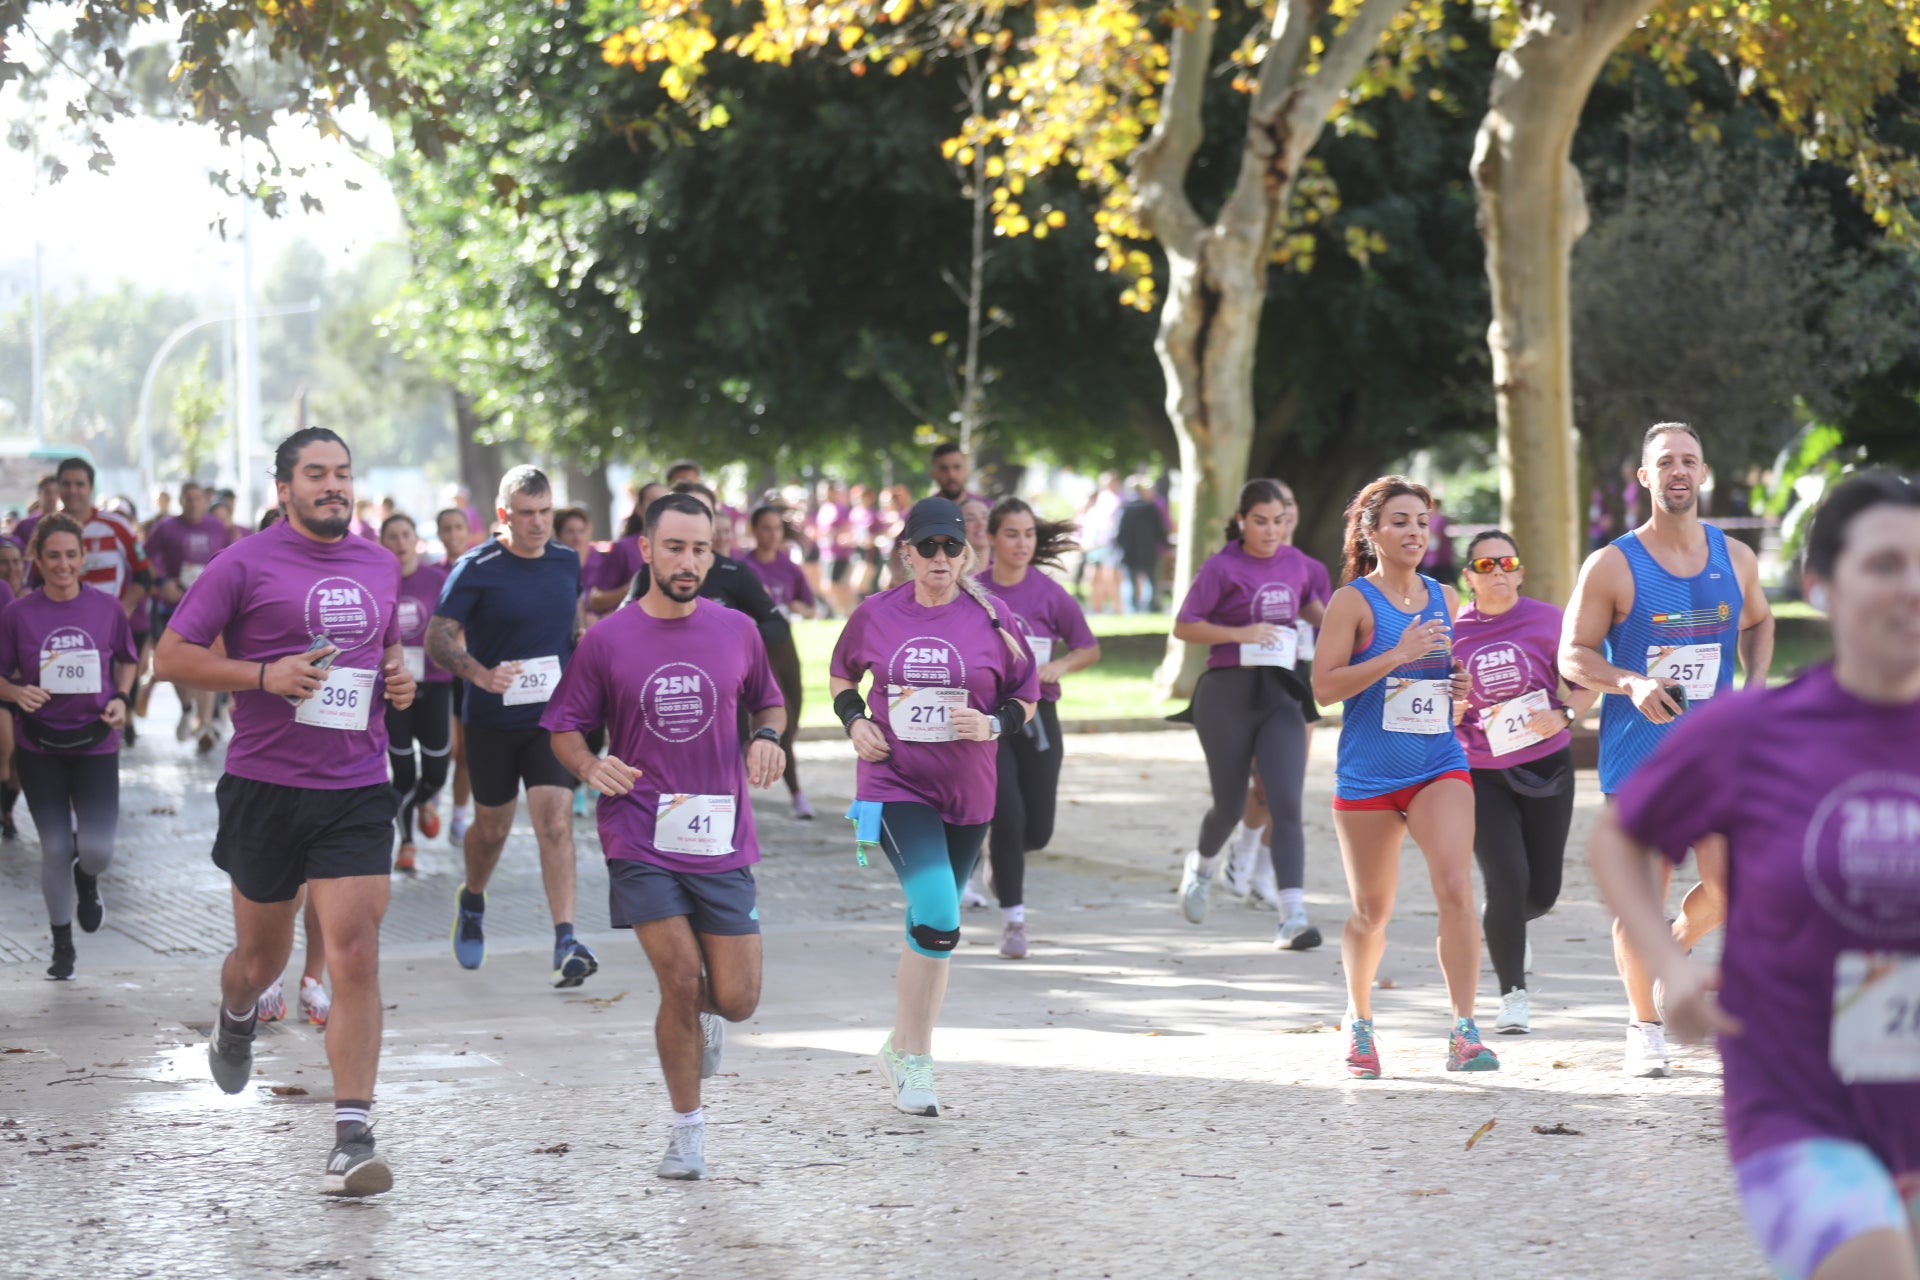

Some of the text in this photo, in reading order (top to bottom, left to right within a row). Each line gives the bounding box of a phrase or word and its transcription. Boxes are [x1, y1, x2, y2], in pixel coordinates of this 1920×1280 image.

[317, 588, 362, 606] 25N
[1261, 590, 1291, 605] 25N
[51, 634, 85, 649] 25N
[905, 647, 949, 664] 25N
[1475, 648, 1516, 670] 25N
[57, 665, 85, 679] 780
[519, 673, 548, 689] 292
[1669, 663, 1705, 681] 257
[654, 675, 701, 696] 25N
[322, 686, 359, 708] 396
[1411, 697, 1434, 715] 64
[911, 705, 945, 723] 271
[687, 815, 711, 834] 41
